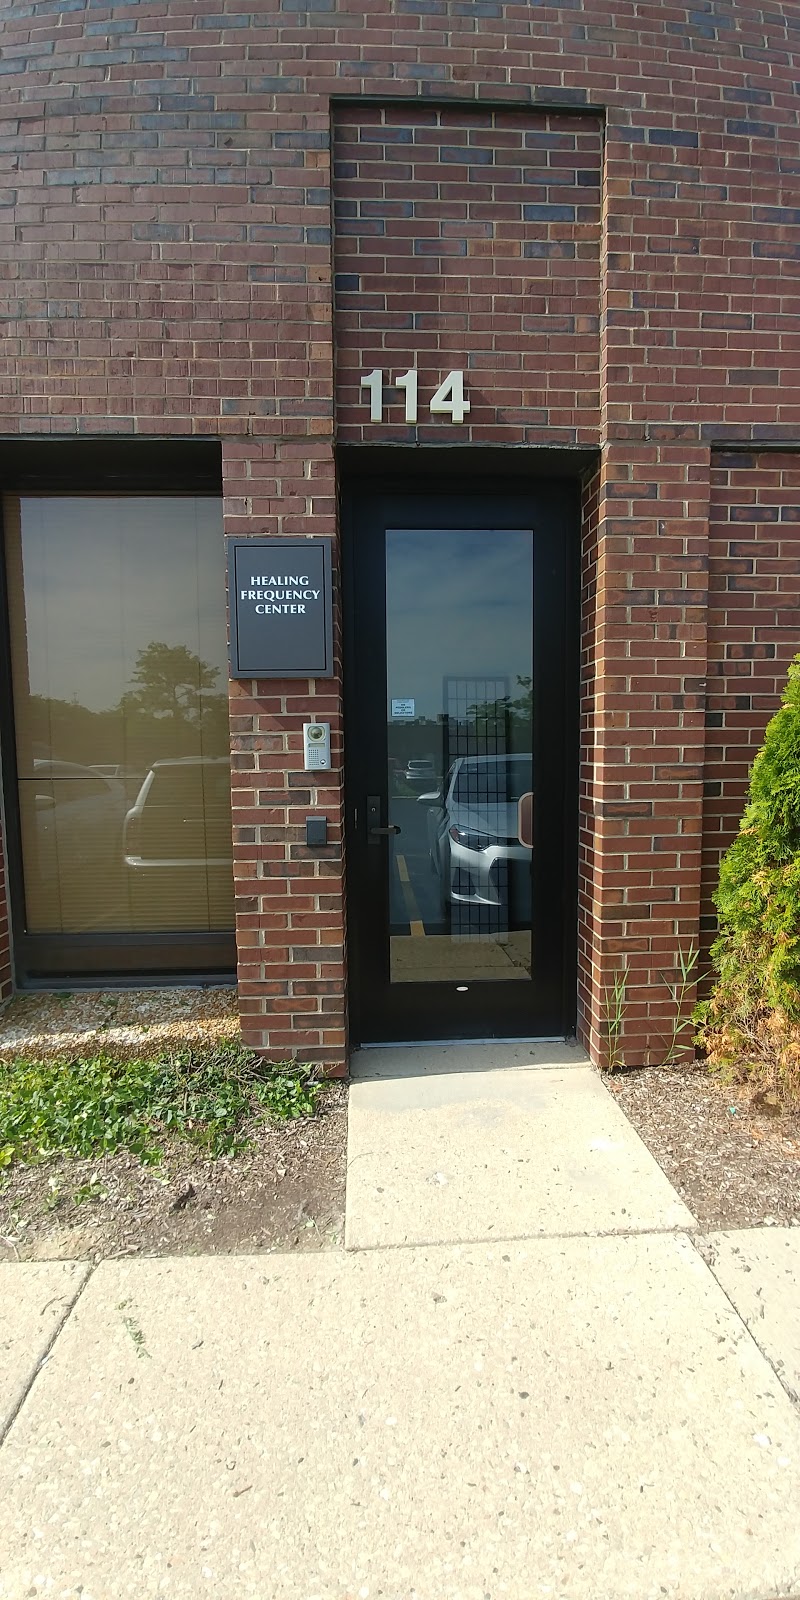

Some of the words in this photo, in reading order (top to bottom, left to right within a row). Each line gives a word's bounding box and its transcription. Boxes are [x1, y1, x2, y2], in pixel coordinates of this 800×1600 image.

[360, 369, 470, 423] 114
[250, 575, 309, 586] HEALING
[240, 589, 321, 602] FREQUENCY
[255, 604, 306, 614] CENTER
